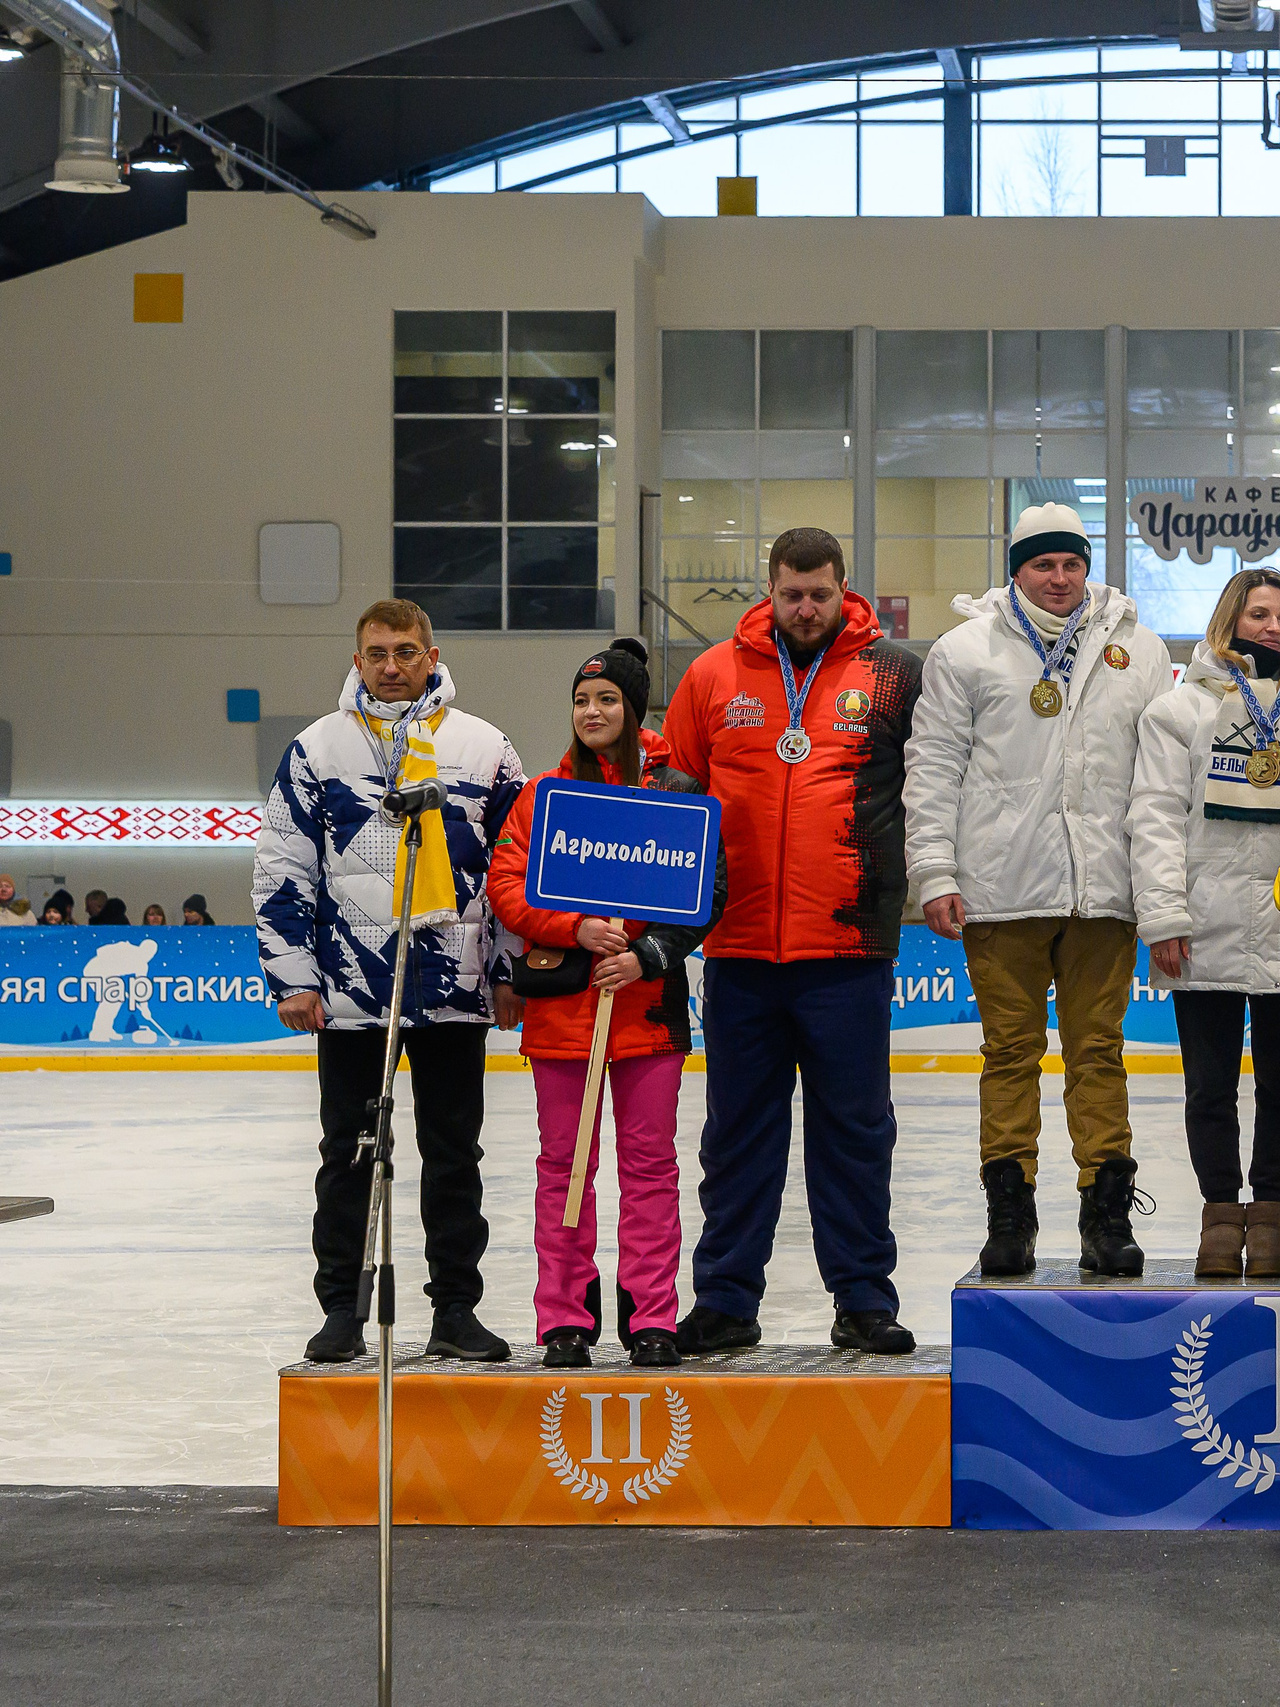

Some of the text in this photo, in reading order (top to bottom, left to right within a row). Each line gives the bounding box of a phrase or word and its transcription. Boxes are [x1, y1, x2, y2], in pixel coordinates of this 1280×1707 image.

[833, 722, 868, 734] BELARUS
[1212, 756, 1247, 774] БЕЛЫ
[550, 829, 697, 869] Агрохолдинг
[57, 975, 277, 1011] спартакиа
[580, 1392, 652, 1464] II
